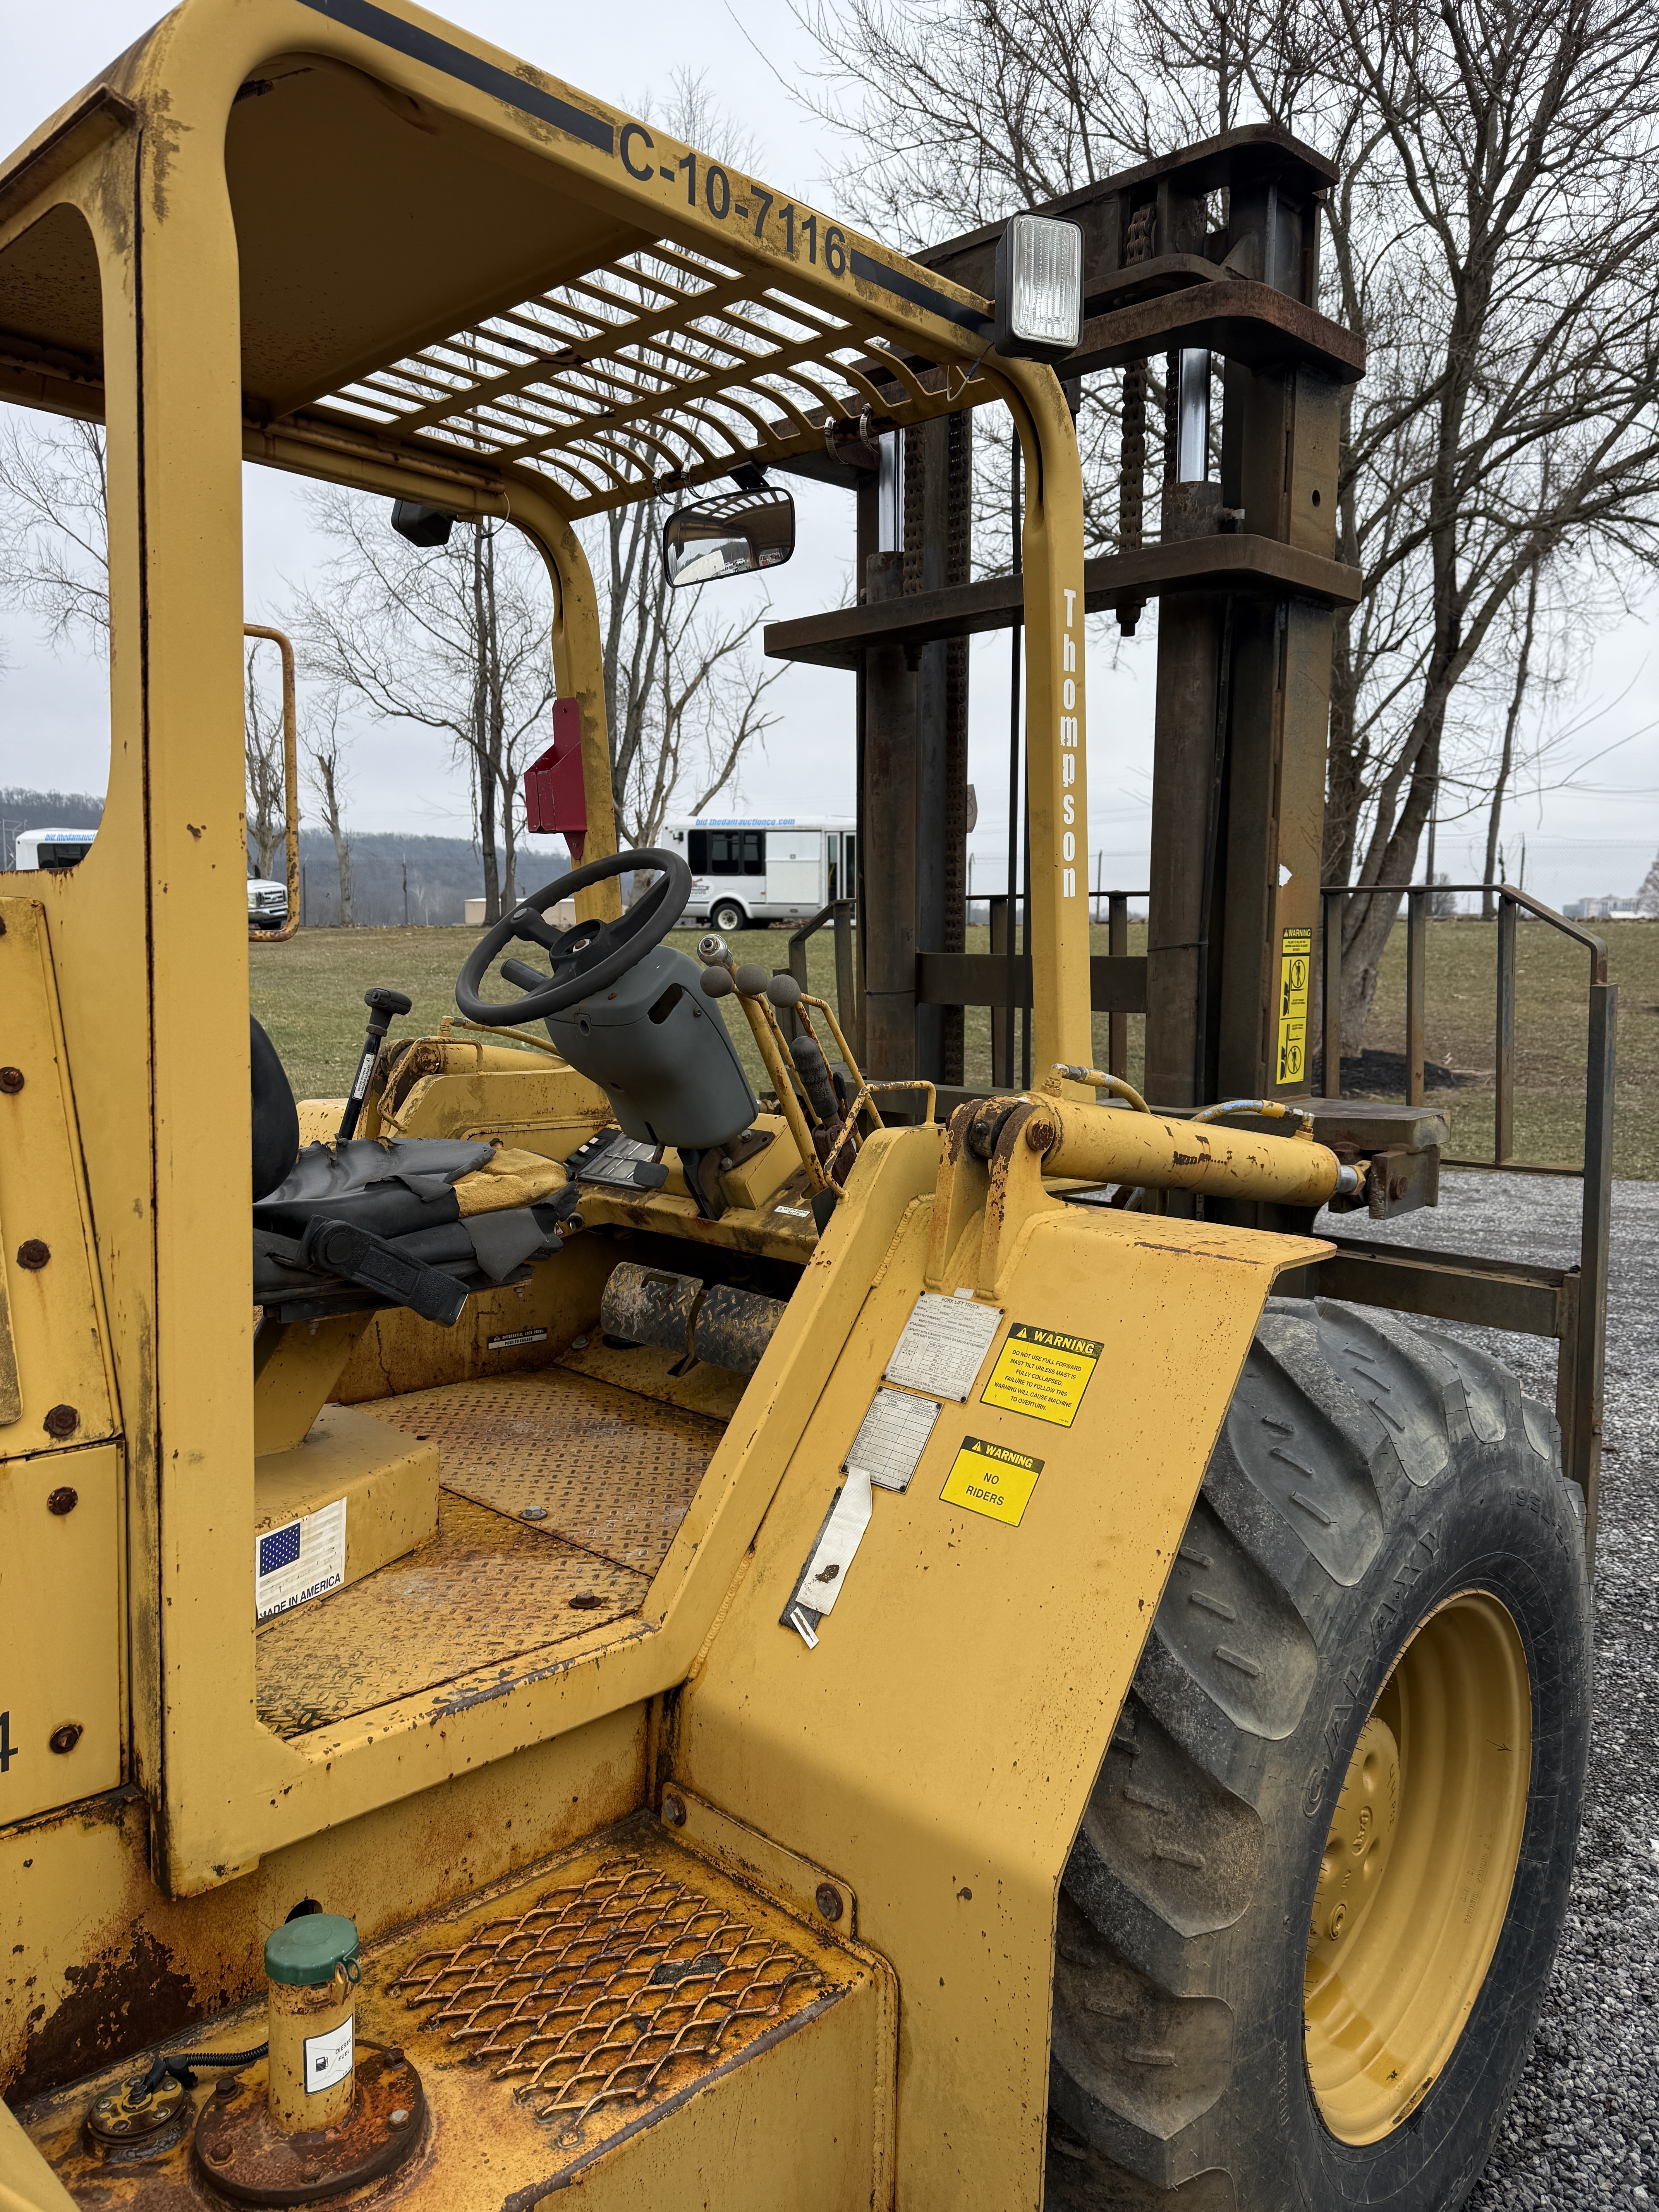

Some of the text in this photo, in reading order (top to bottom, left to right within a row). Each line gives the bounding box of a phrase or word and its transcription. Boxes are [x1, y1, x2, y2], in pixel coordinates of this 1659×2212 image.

[620, 123, 846, 276] C-10-7116
[1061, 588, 1078, 898] Thompson
[1032, 1330, 1095, 1355] WARNING
[1035, 1365, 1056, 1374] UNLESS
[1055, 1370, 1071, 1378] MAST
[1055, 1360, 1082, 1372] FORWARD
[1004, 1375, 1025, 1385] FAILURE
[1033, 1383, 1055, 1393] FOLLOW
[1015, 1369, 1063, 1386] FULLY COLLAPSED.
[993, 1381, 1017, 1392] WARNING
[1029, 1391, 1048, 1401] CAUSE
[1048, 1396, 1072, 1408] MACHINE
[1017, 1398, 1047, 1410] OVERTURN.
[984, 1445, 1034, 1468] WARNING
[982, 1472, 1000, 1486] NO
[965, 1484, 1005, 1506] RIDERS
[289, 1594, 298, 1606] IN
[300, 1573, 341, 1602] AMERICA
[1303, 1514, 1442, 1818] GALAXY
[335, 2036, 352, 2054] DIESEL
[338, 2049, 350, 2062] FUEL
